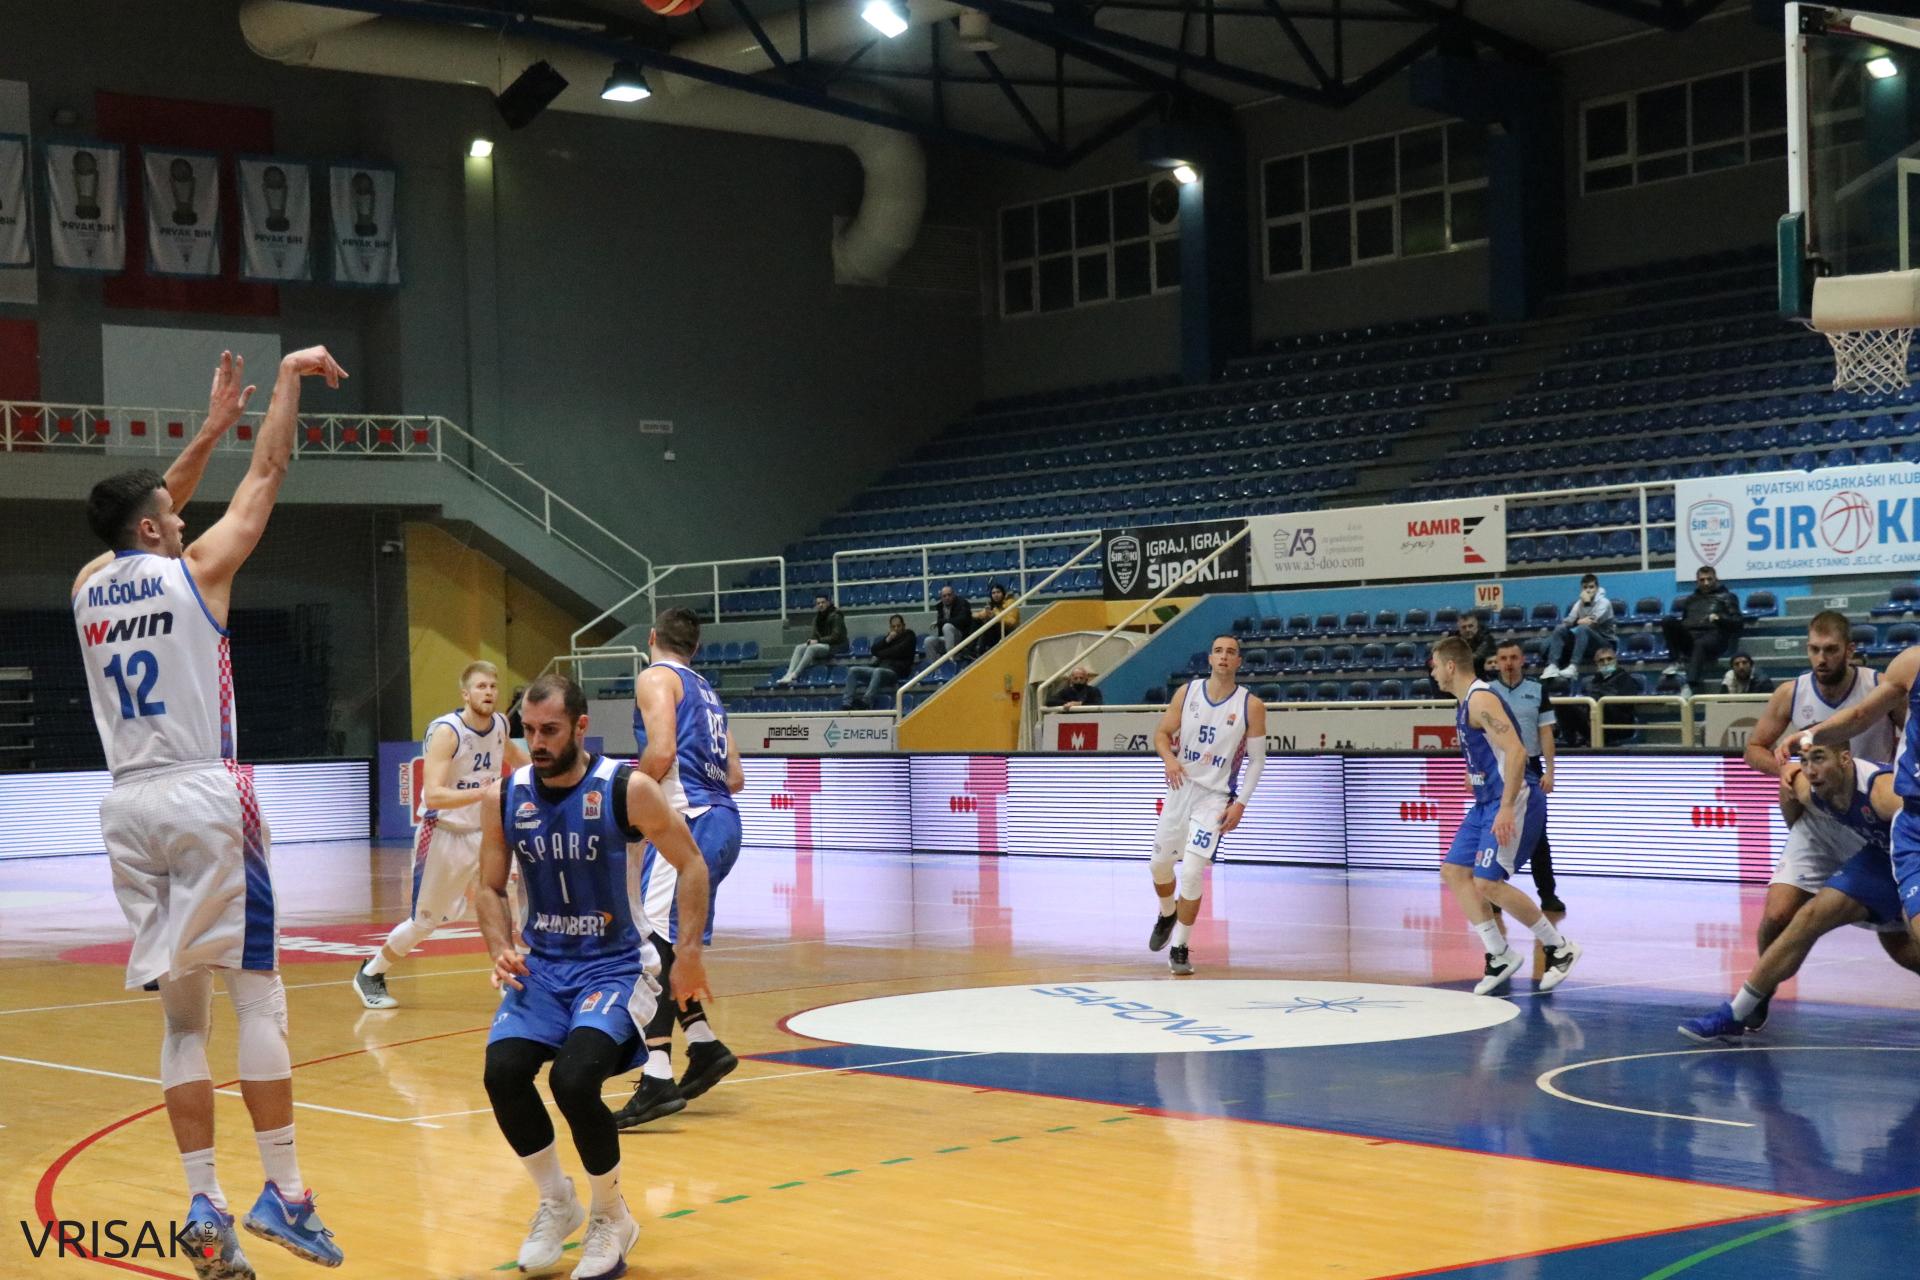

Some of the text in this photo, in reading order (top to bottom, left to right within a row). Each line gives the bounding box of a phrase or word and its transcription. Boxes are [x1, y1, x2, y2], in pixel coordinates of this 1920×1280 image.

[61, 220, 95, 231] PRVAK
[1745, 471, 1920, 497] HRVATSKI KOŠARKAŠKI KLUB
[1407, 518, 1461, 538] KAMIR
[1146, 537, 1188, 557] IGRAJ,
[1274, 557, 1365, 573] www.a3-doo.com
[88, 576, 165, 607] M.ČOLAK
[1478, 586, 1500, 602] VIP
[103, 650, 166, 720] 12
[706, 708, 728, 759] 95
[769, 725, 810, 737] mandeks
[843, 729, 888, 740] EMERUS
[1198, 725, 1217, 745] 55
[473, 752, 491, 772] 24
[584, 806, 599, 817] ABA
[518, 832, 600, 863] SPARS
[1193, 829, 1213, 849] 55
[1482, 848, 1495, 868] 8
[559, 871, 571, 904] 1
[601, 992, 620, 1015] 1
[1030, 986, 1256, 1046] SAPONIA
